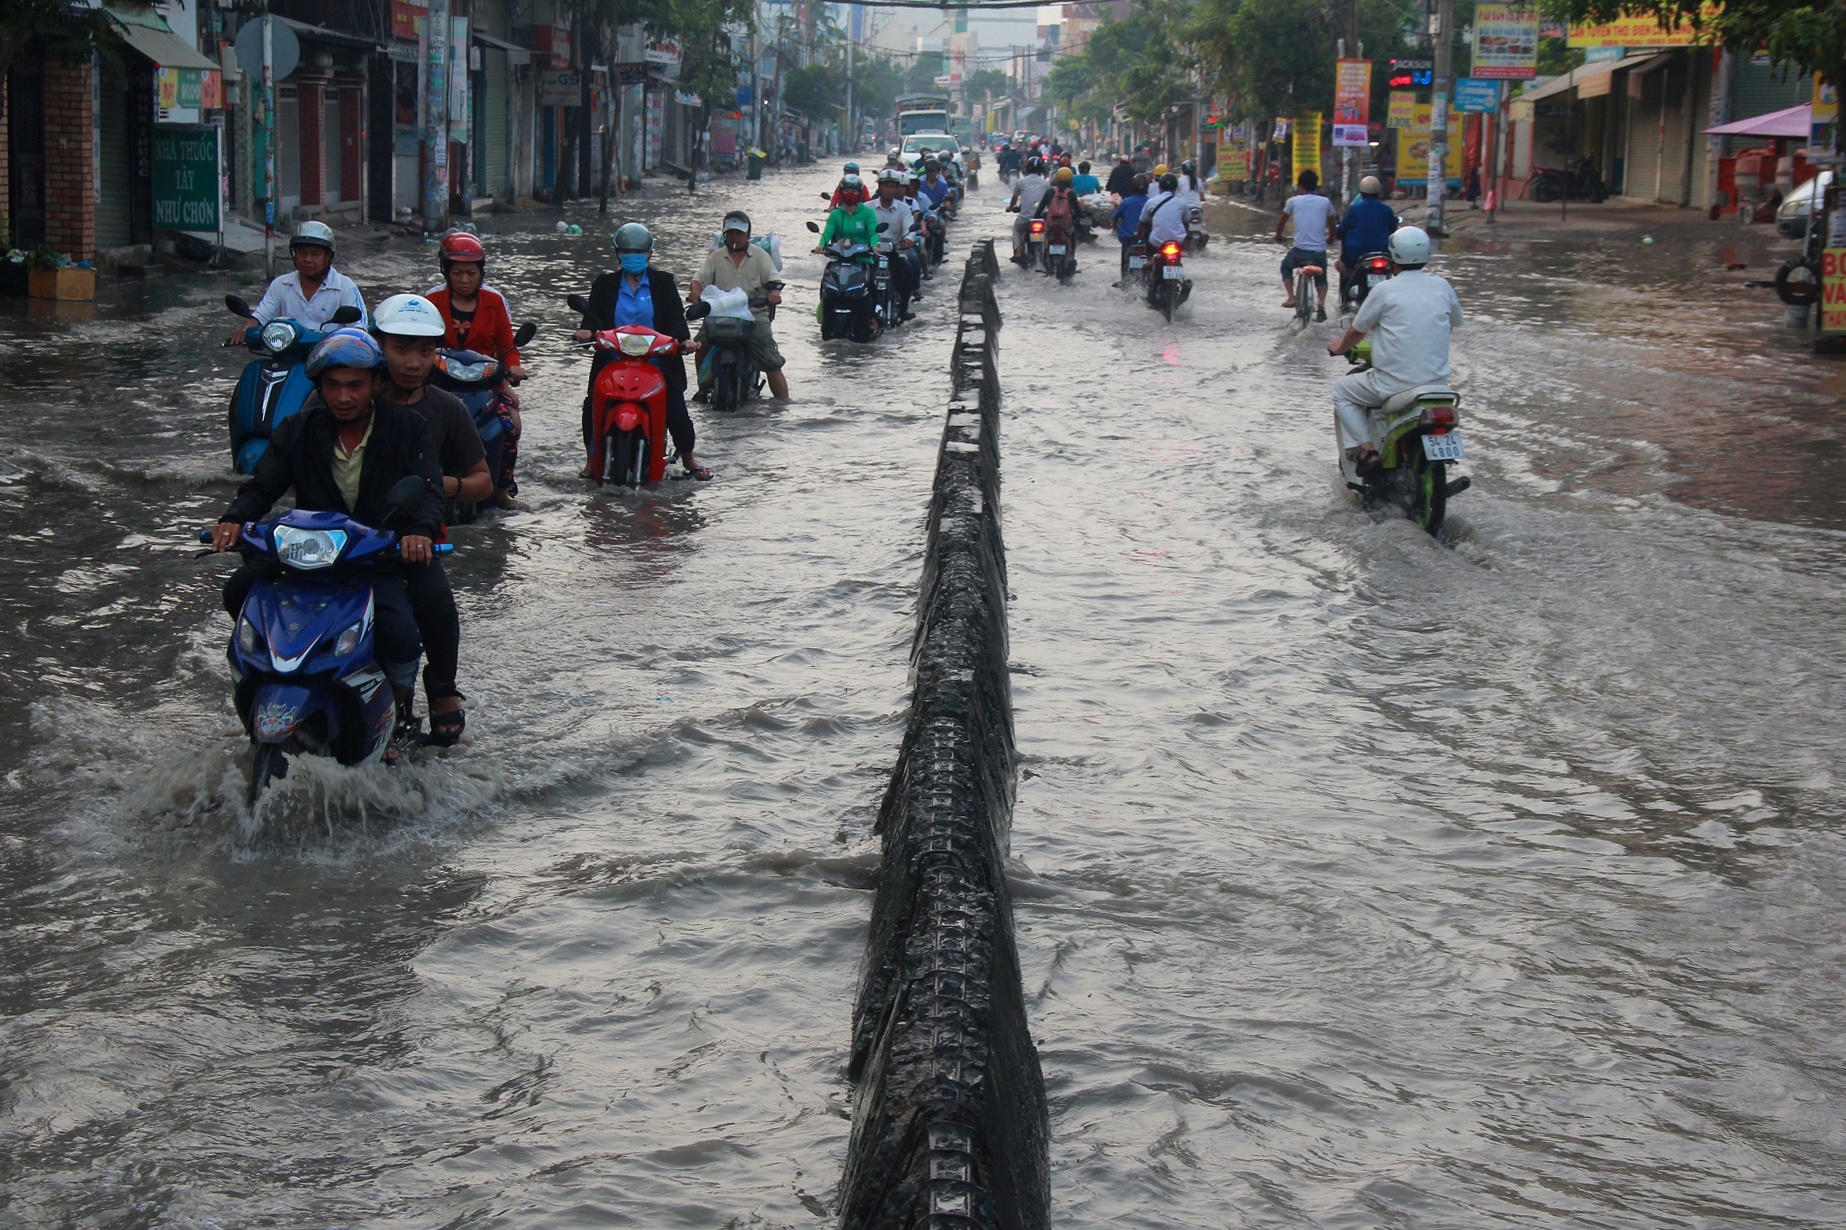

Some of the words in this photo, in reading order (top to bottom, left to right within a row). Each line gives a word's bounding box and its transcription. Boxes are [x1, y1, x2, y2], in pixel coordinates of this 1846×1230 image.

[618, 64, 645, 73] OTEL
[155, 135, 177, 160] NHÀ
[180, 131, 214, 161] THUỐC
[175, 164, 195, 190] TÂY
[156, 195, 182, 223] NHƯ
[183, 197, 215, 224] CHƠN
[1431, 446, 1460, 458] 4800
